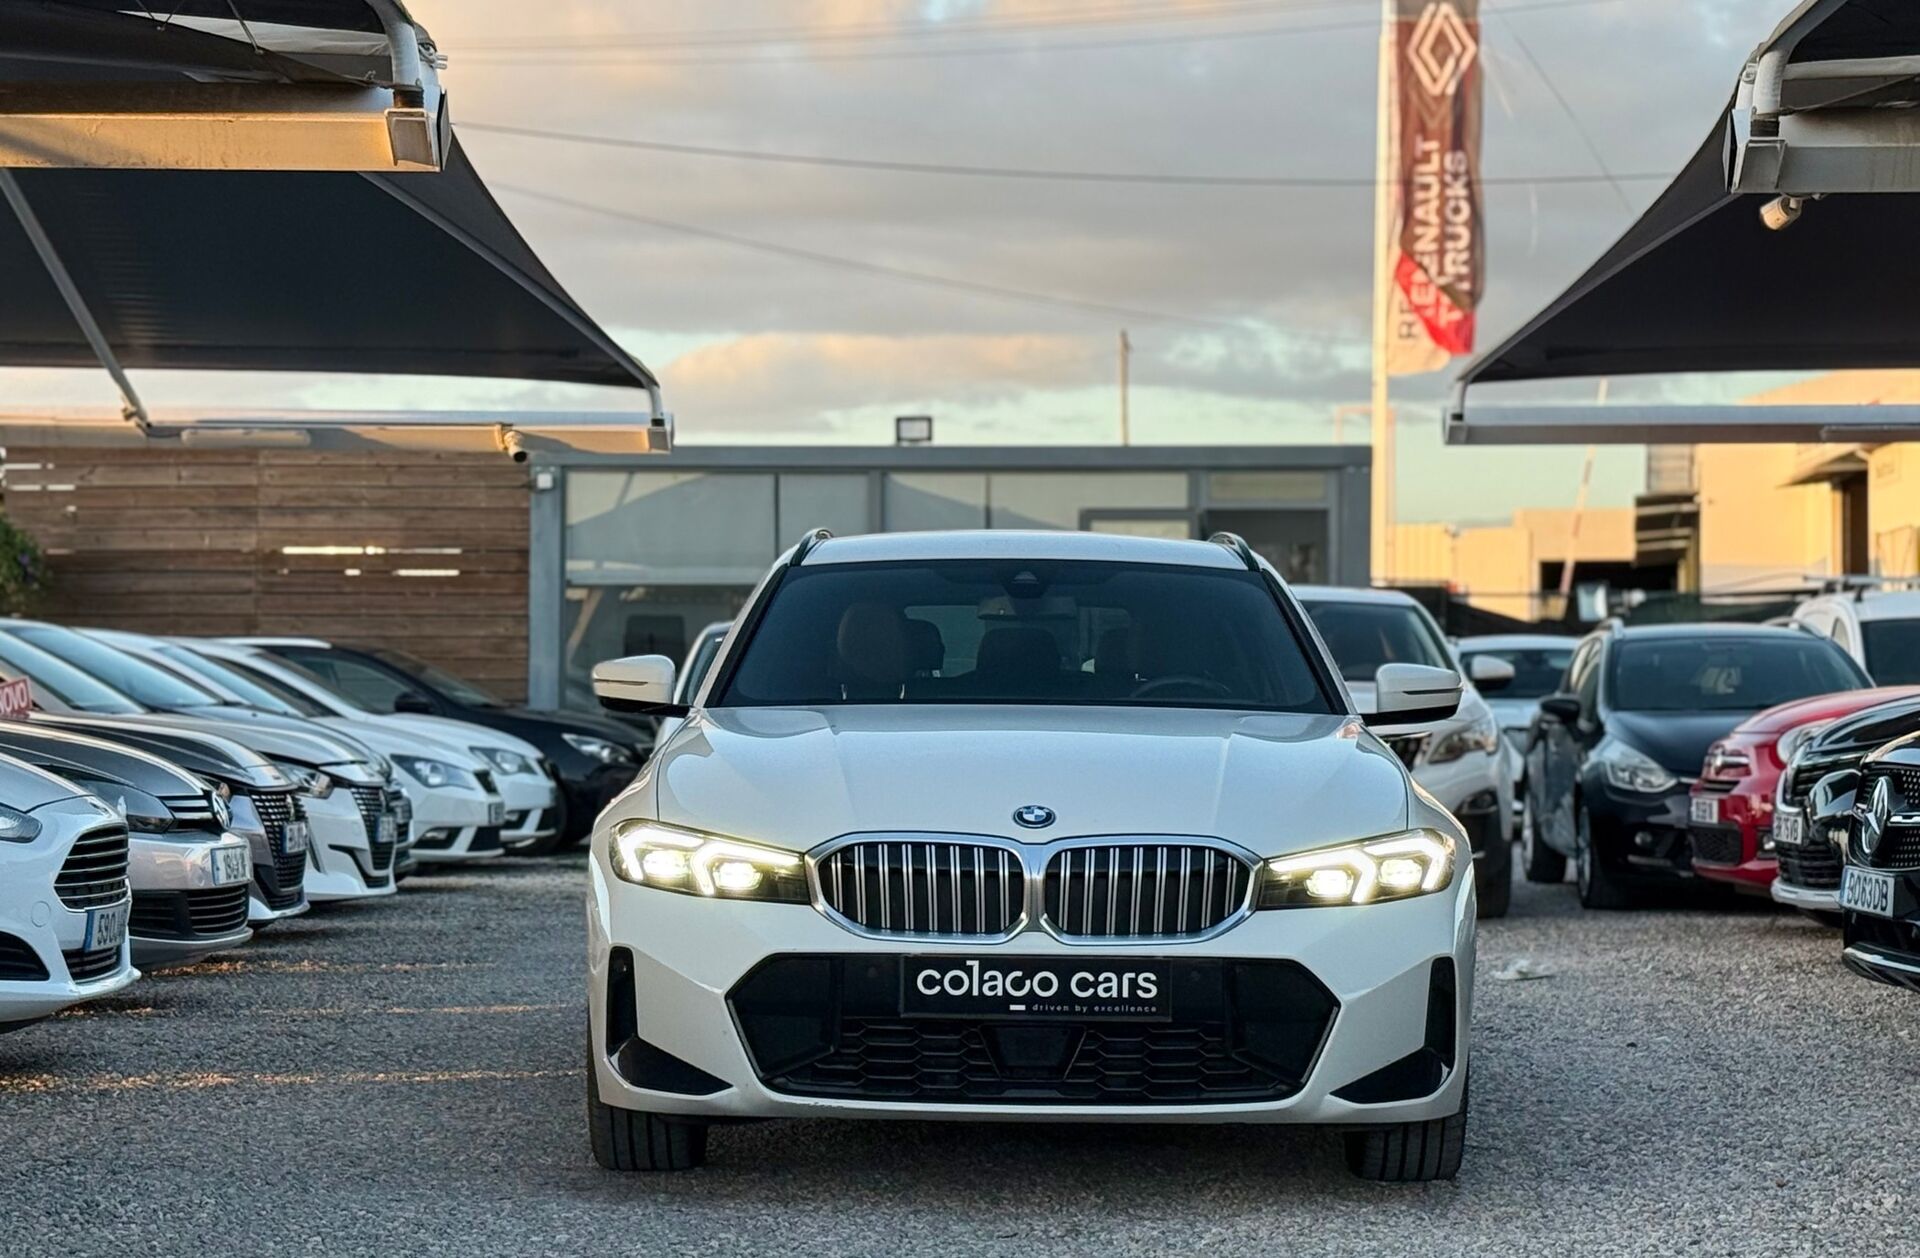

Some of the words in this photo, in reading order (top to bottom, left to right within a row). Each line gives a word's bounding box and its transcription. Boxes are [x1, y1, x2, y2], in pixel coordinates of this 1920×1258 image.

[1070, 971, 1158, 999] cars
[1032, 1004, 1069, 1012] driven
[1075, 1004, 1088, 1013] by
[1094, 1004, 1157, 1013] excellence
